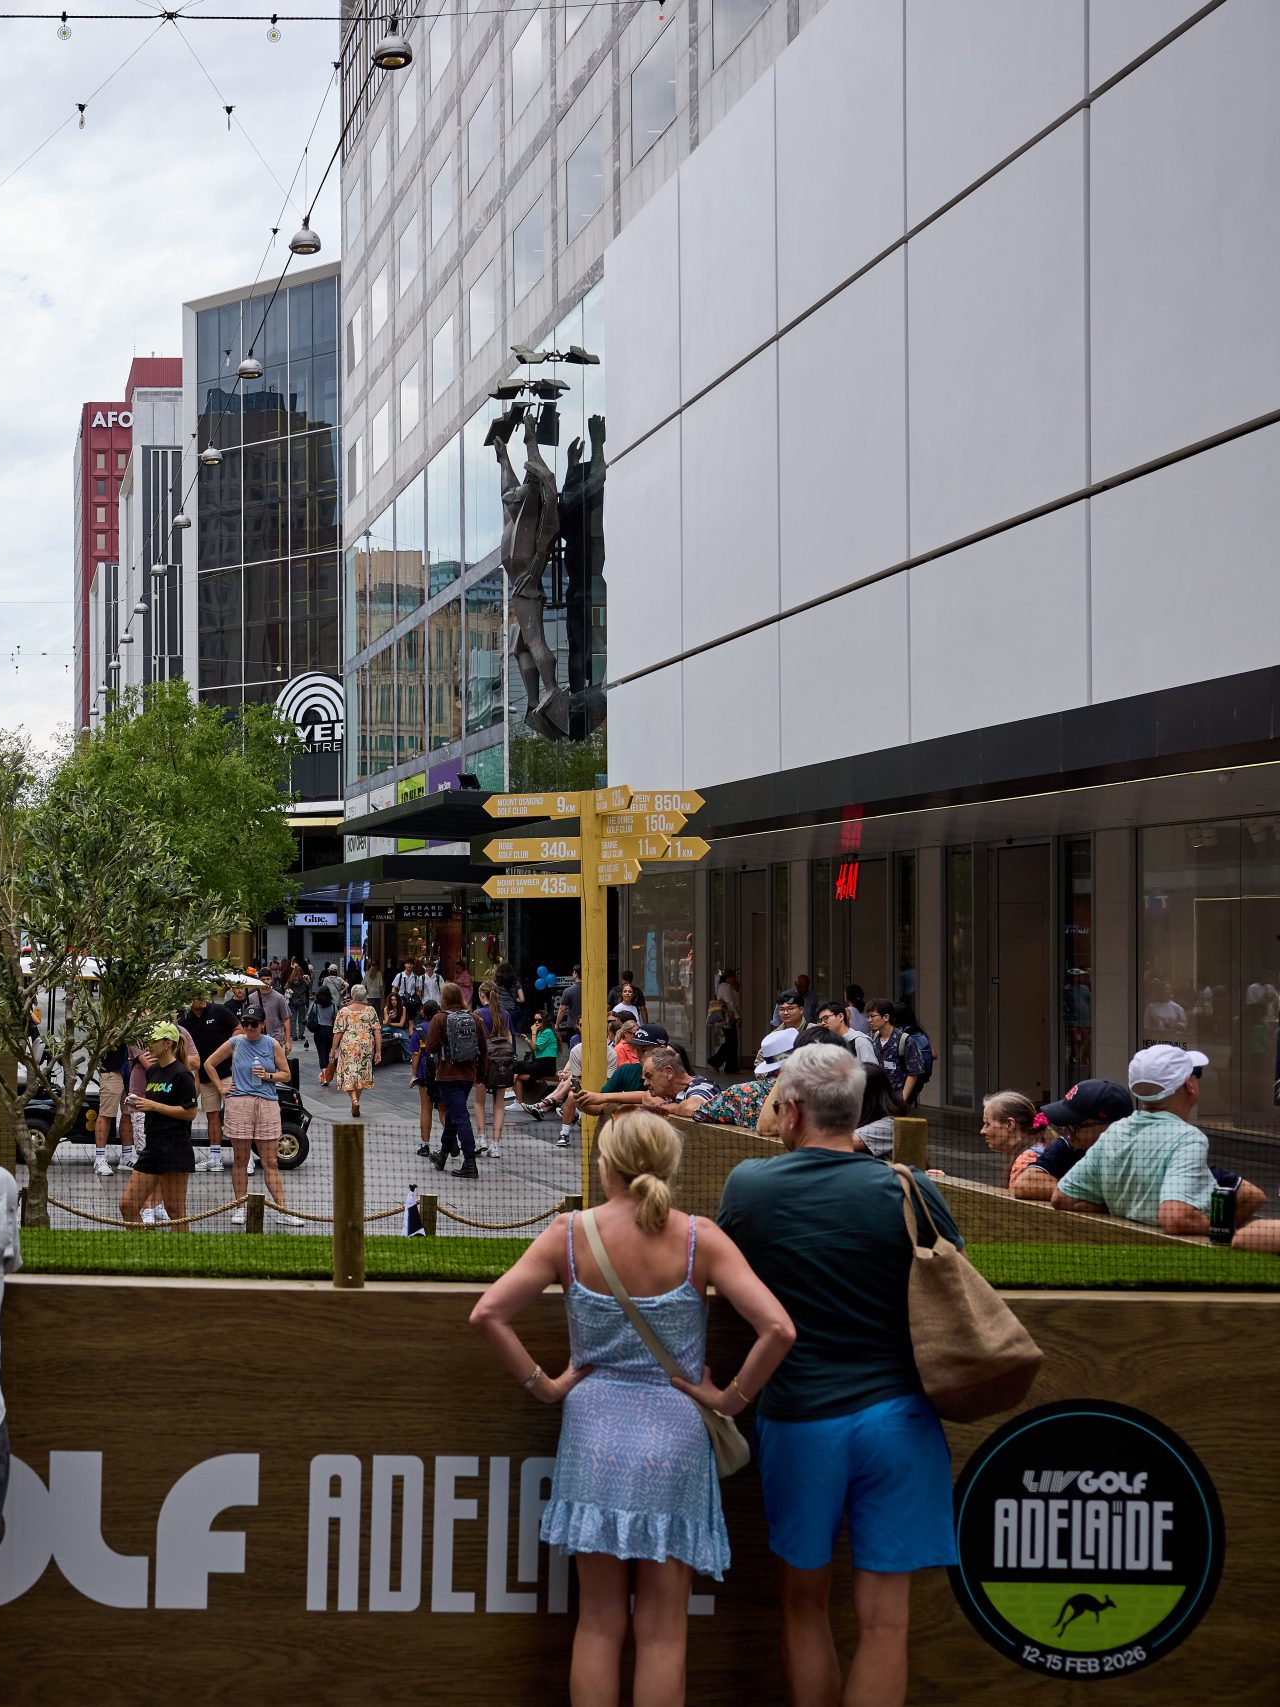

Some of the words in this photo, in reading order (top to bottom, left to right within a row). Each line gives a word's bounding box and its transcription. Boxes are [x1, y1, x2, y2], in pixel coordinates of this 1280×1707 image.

[497, 798, 517, 807] MOUNT
[518, 797, 544, 806] OSMOND
[497, 807, 511, 816] GOLF
[512, 806, 528, 815] CLUB
[630, 803, 648, 812] IELDS
[606, 826, 619, 834] GOLF
[620, 825, 633, 833] CLUB
[498, 842, 513, 850] ROBE
[498, 851, 512, 859] GOLF
[513, 850, 529, 859] CLUB
[497, 879, 516, 888] MOUNT
[516, 878, 540, 887] GAMBIER
[835, 862, 859, 901] H&M
[496, 887, 511, 895] GOLF
[511, 886, 524, 894] CLUB
[1022, 1470, 1080, 1493] LIV
[1077, 1470, 1148, 1494] GOLF
[306, 1454, 716, 1616] ADELA
[1021, 1645, 1062, 1671] 12-15
[1065, 1658, 1100, 1674] FEB
[1102, 1646, 1147, 1672] 2026
